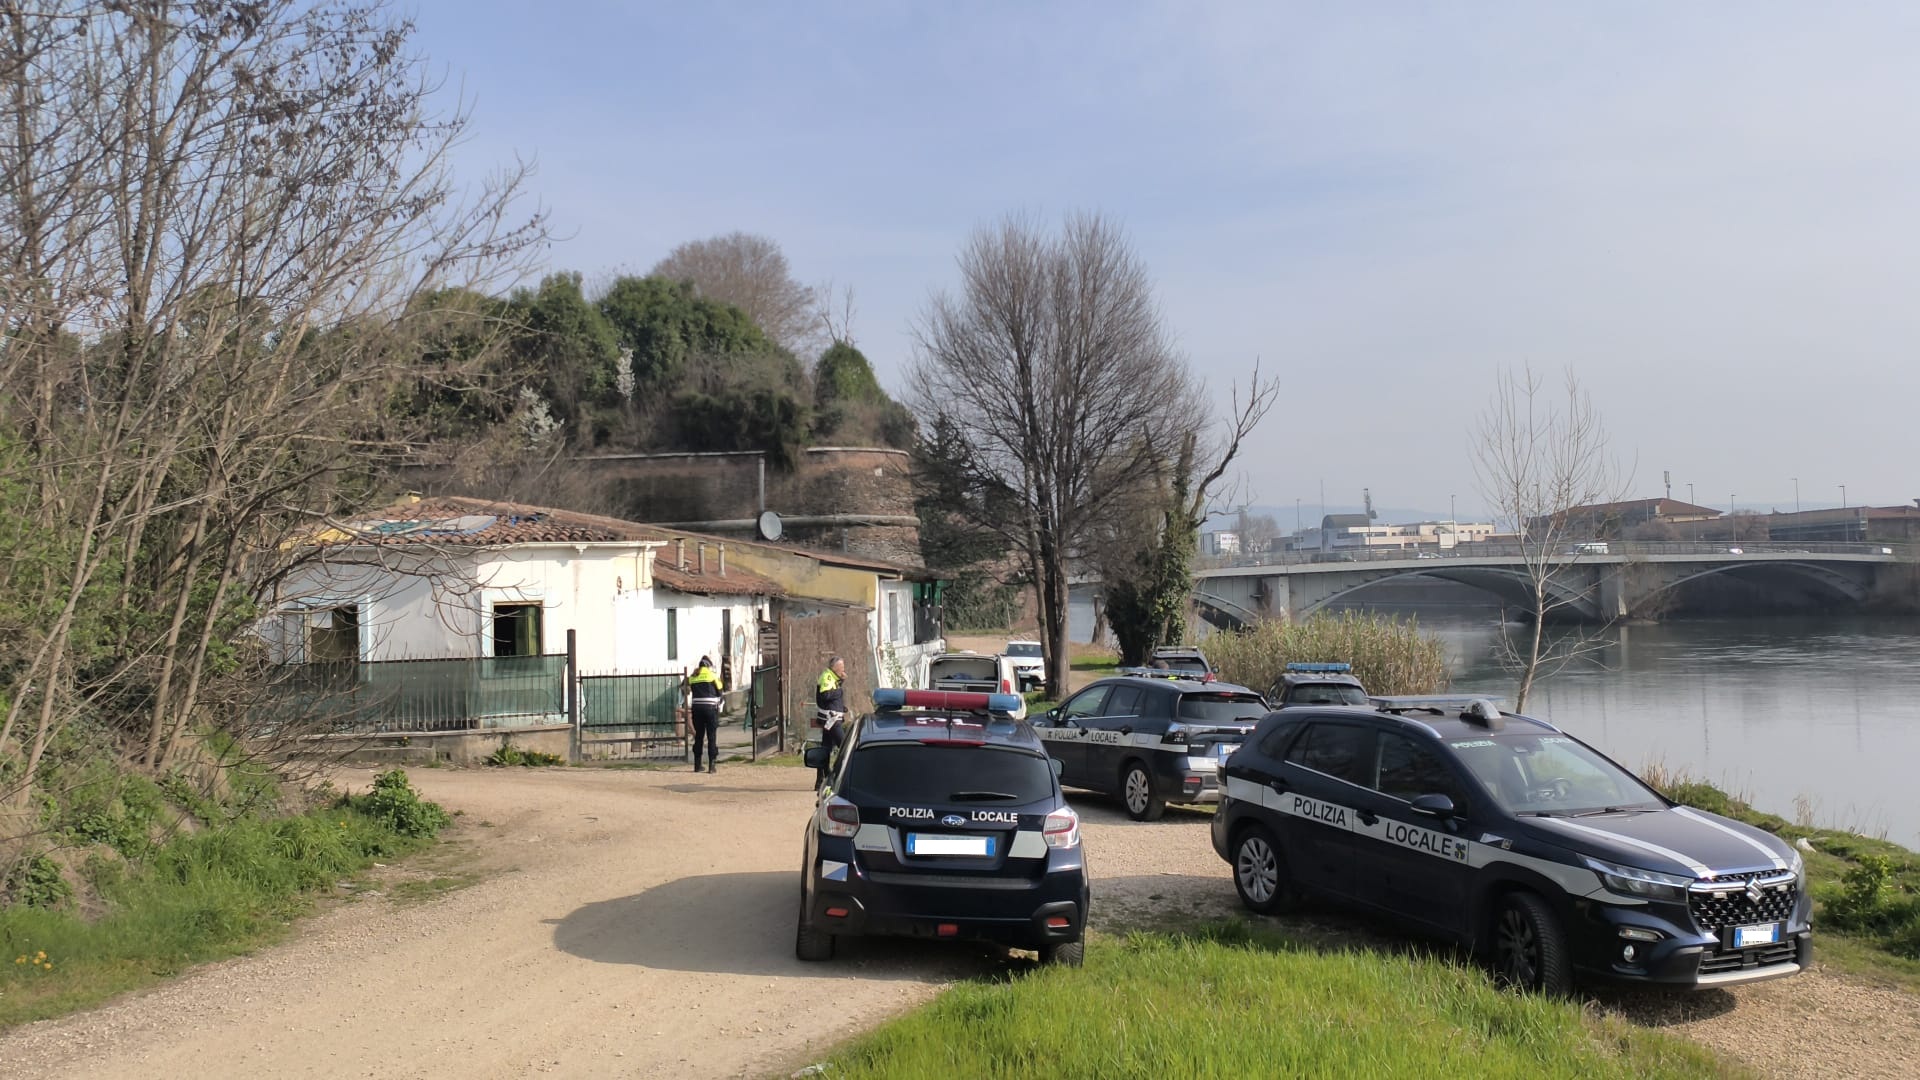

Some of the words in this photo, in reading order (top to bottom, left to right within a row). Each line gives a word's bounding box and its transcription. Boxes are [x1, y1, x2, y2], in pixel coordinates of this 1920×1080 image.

[1054, 730, 1078, 740] POLIZIA
[1091, 732, 1118, 743] LOCALE
[889, 806, 935, 819] POLIZIA
[971, 811, 1018, 823] LOCALE
[1293, 797, 1347, 827] POLIZIA
[1386, 822, 1452, 857] LOCALE
